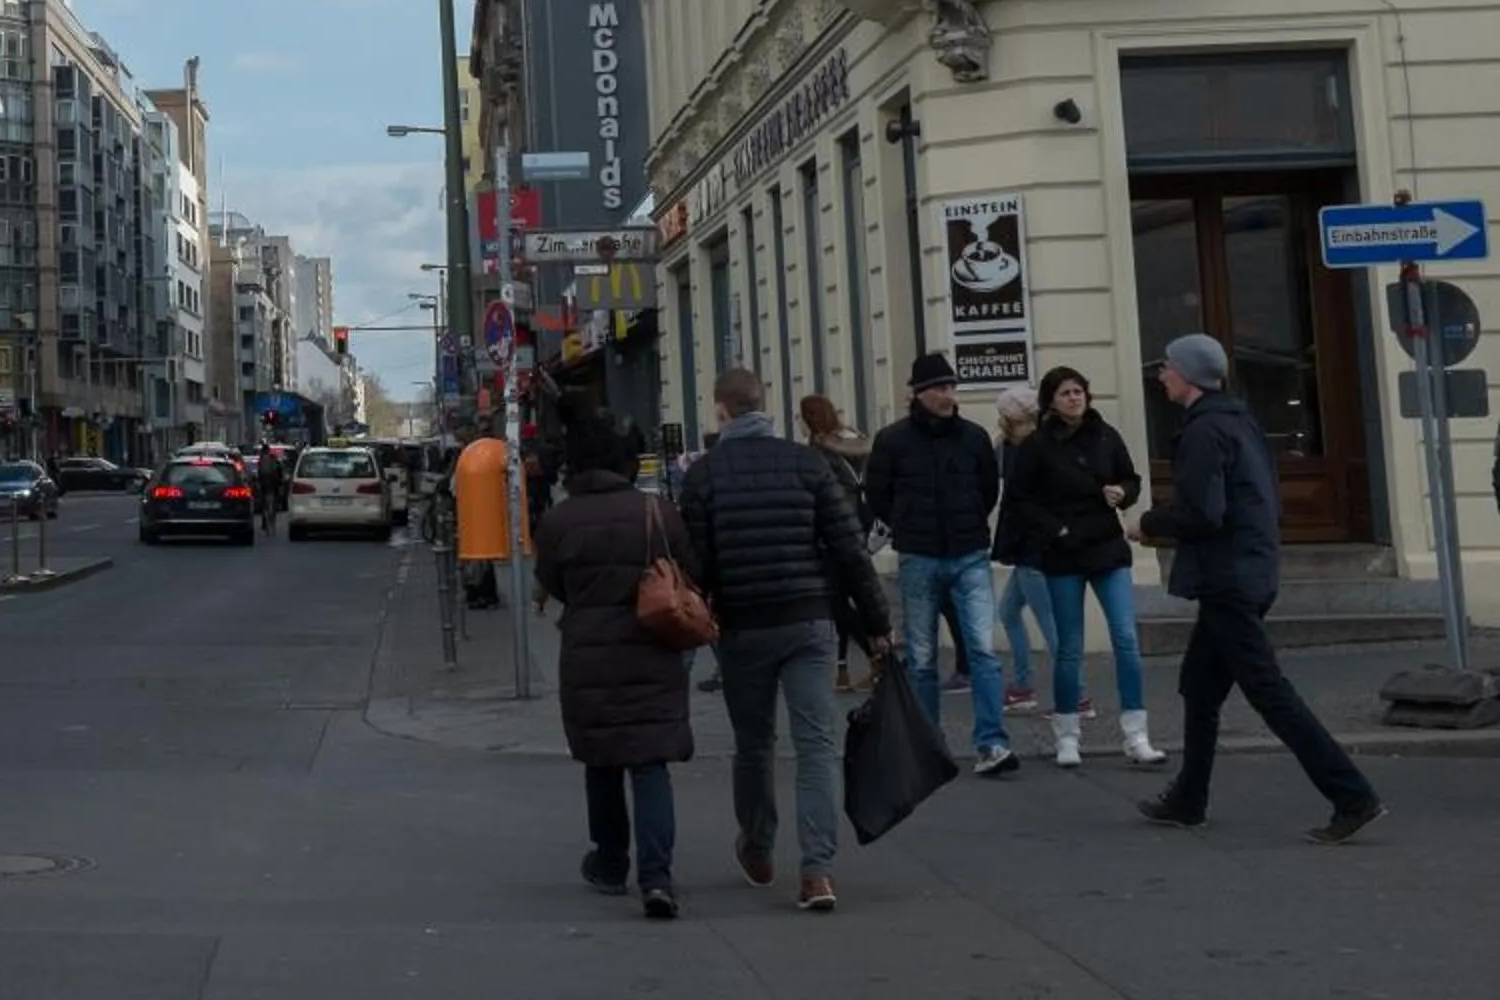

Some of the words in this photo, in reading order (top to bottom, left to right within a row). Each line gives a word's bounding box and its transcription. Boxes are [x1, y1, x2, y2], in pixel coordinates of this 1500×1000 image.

[589, 3, 622, 208] McDonalds
[945, 200, 1018, 216] EINSTEIN
[1331, 225, 1438, 244] Einbahnstraße
[955, 302, 1023, 318] KAFFEE
[960, 363, 1026, 379] CHARLIE
